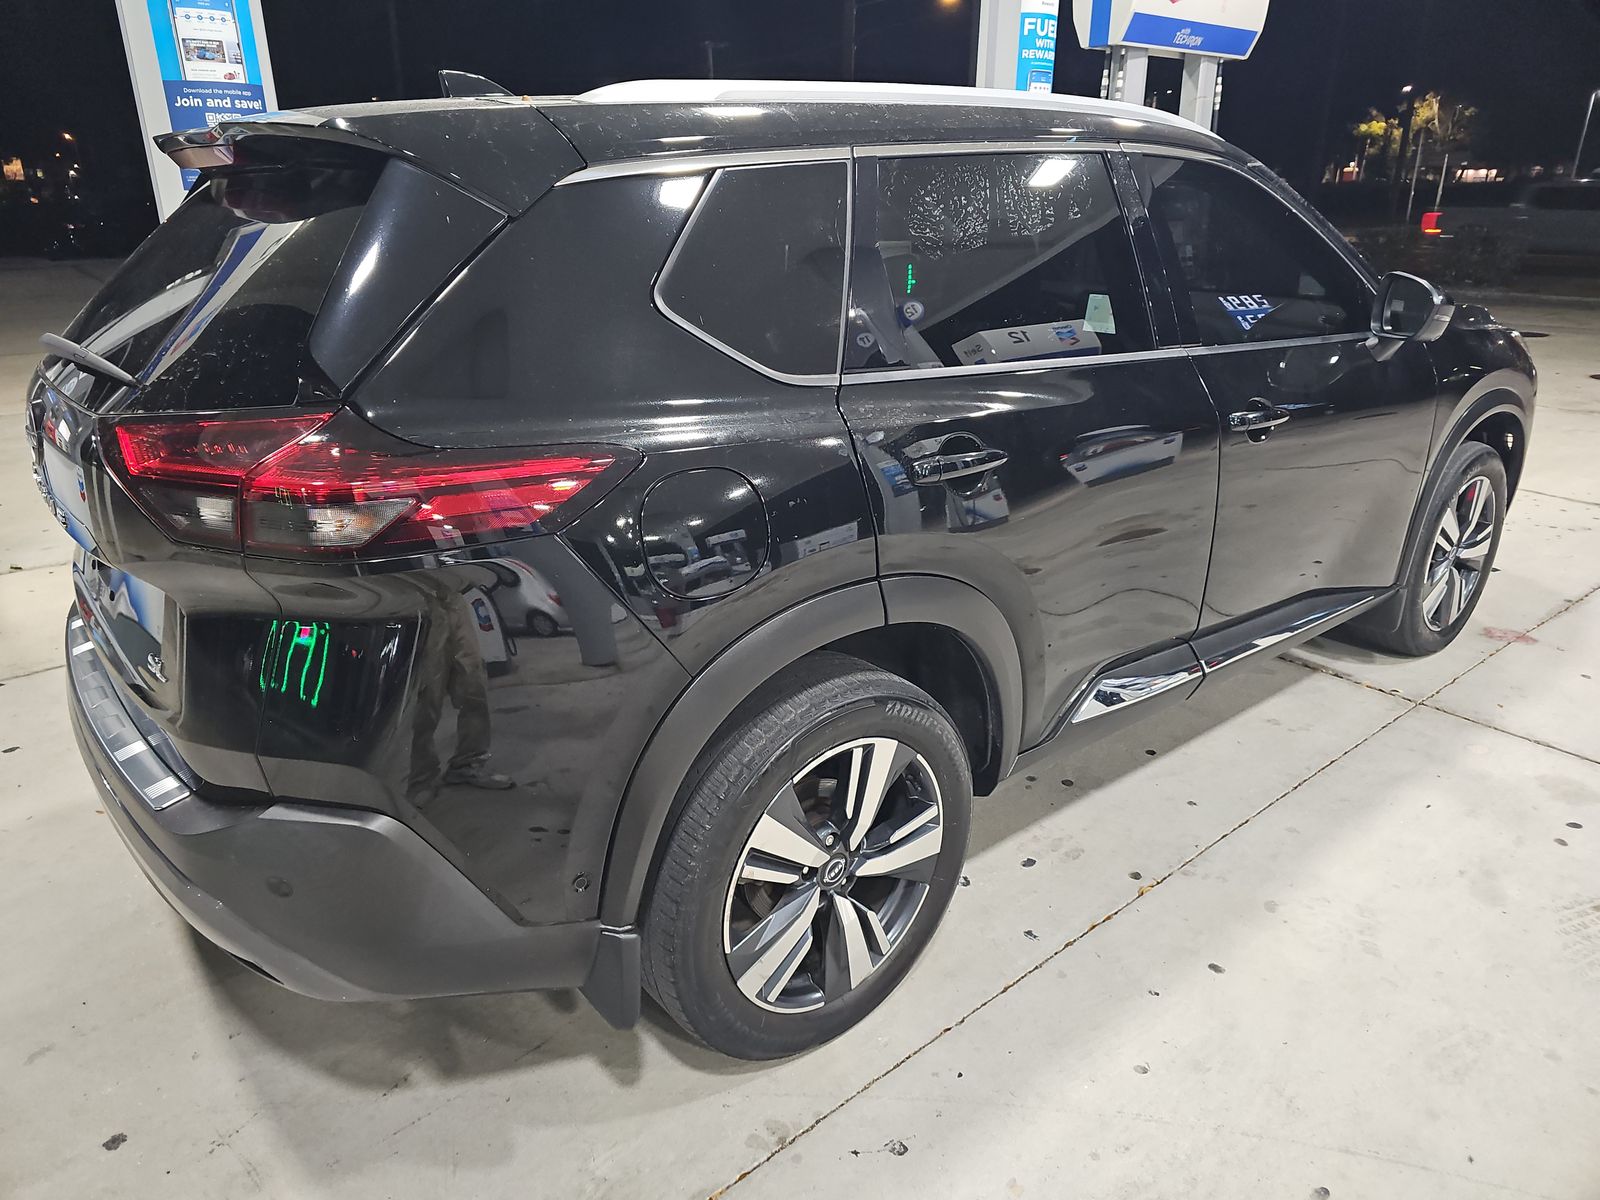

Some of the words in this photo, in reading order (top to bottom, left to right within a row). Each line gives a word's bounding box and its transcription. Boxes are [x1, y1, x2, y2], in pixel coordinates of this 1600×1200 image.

[183, 87, 212, 95] Download
[174, 95, 203, 107] Join
[206, 98, 231, 108] and
[234, 100, 263, 110] save!
